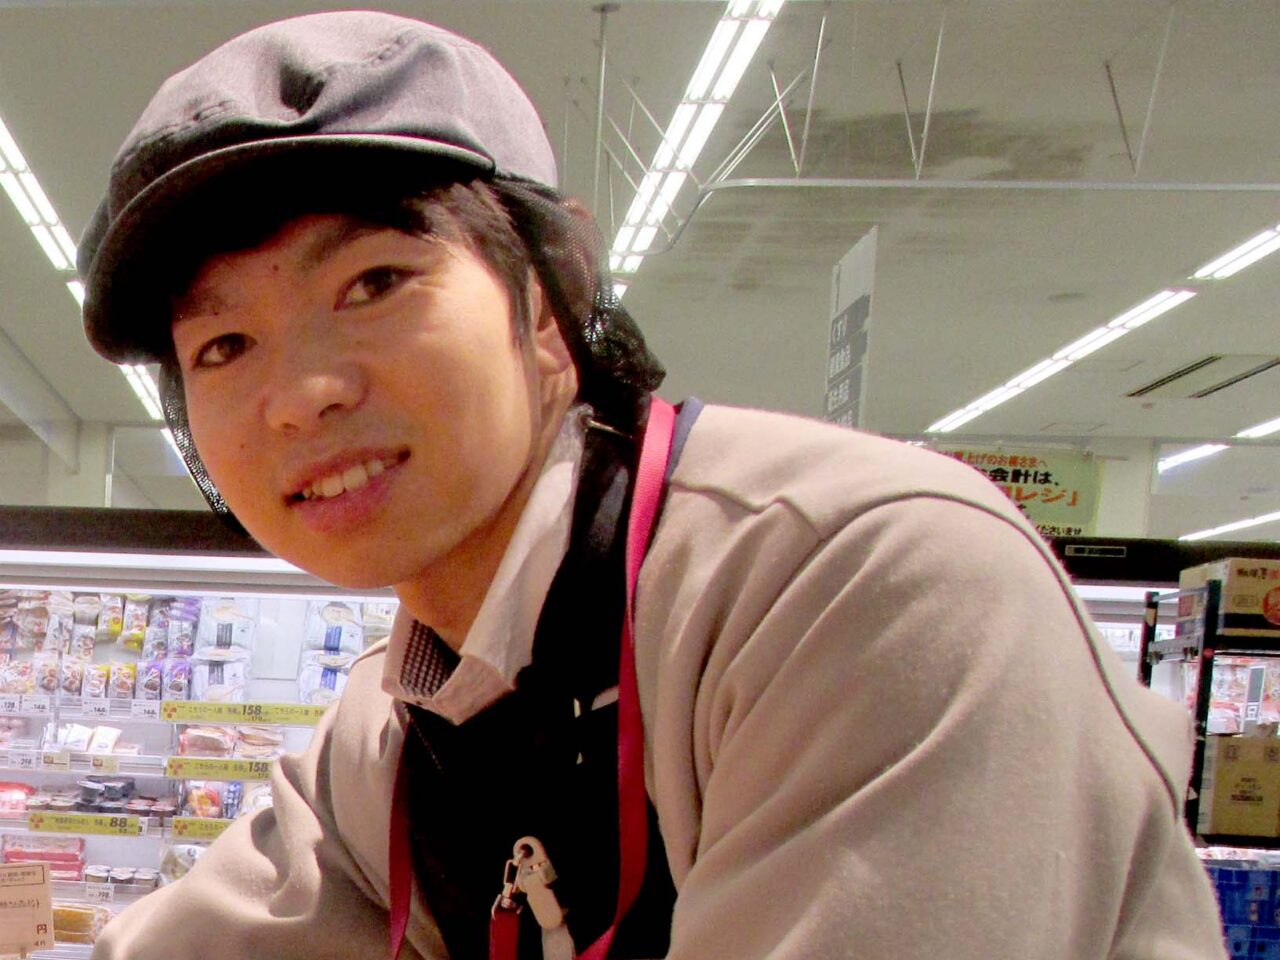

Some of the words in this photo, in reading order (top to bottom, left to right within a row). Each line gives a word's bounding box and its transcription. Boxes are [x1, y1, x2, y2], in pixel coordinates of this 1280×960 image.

[242, 704, 262, 716] 158
[248, 762, 269, 773] 158
[109, 817, 128, 828] 88
